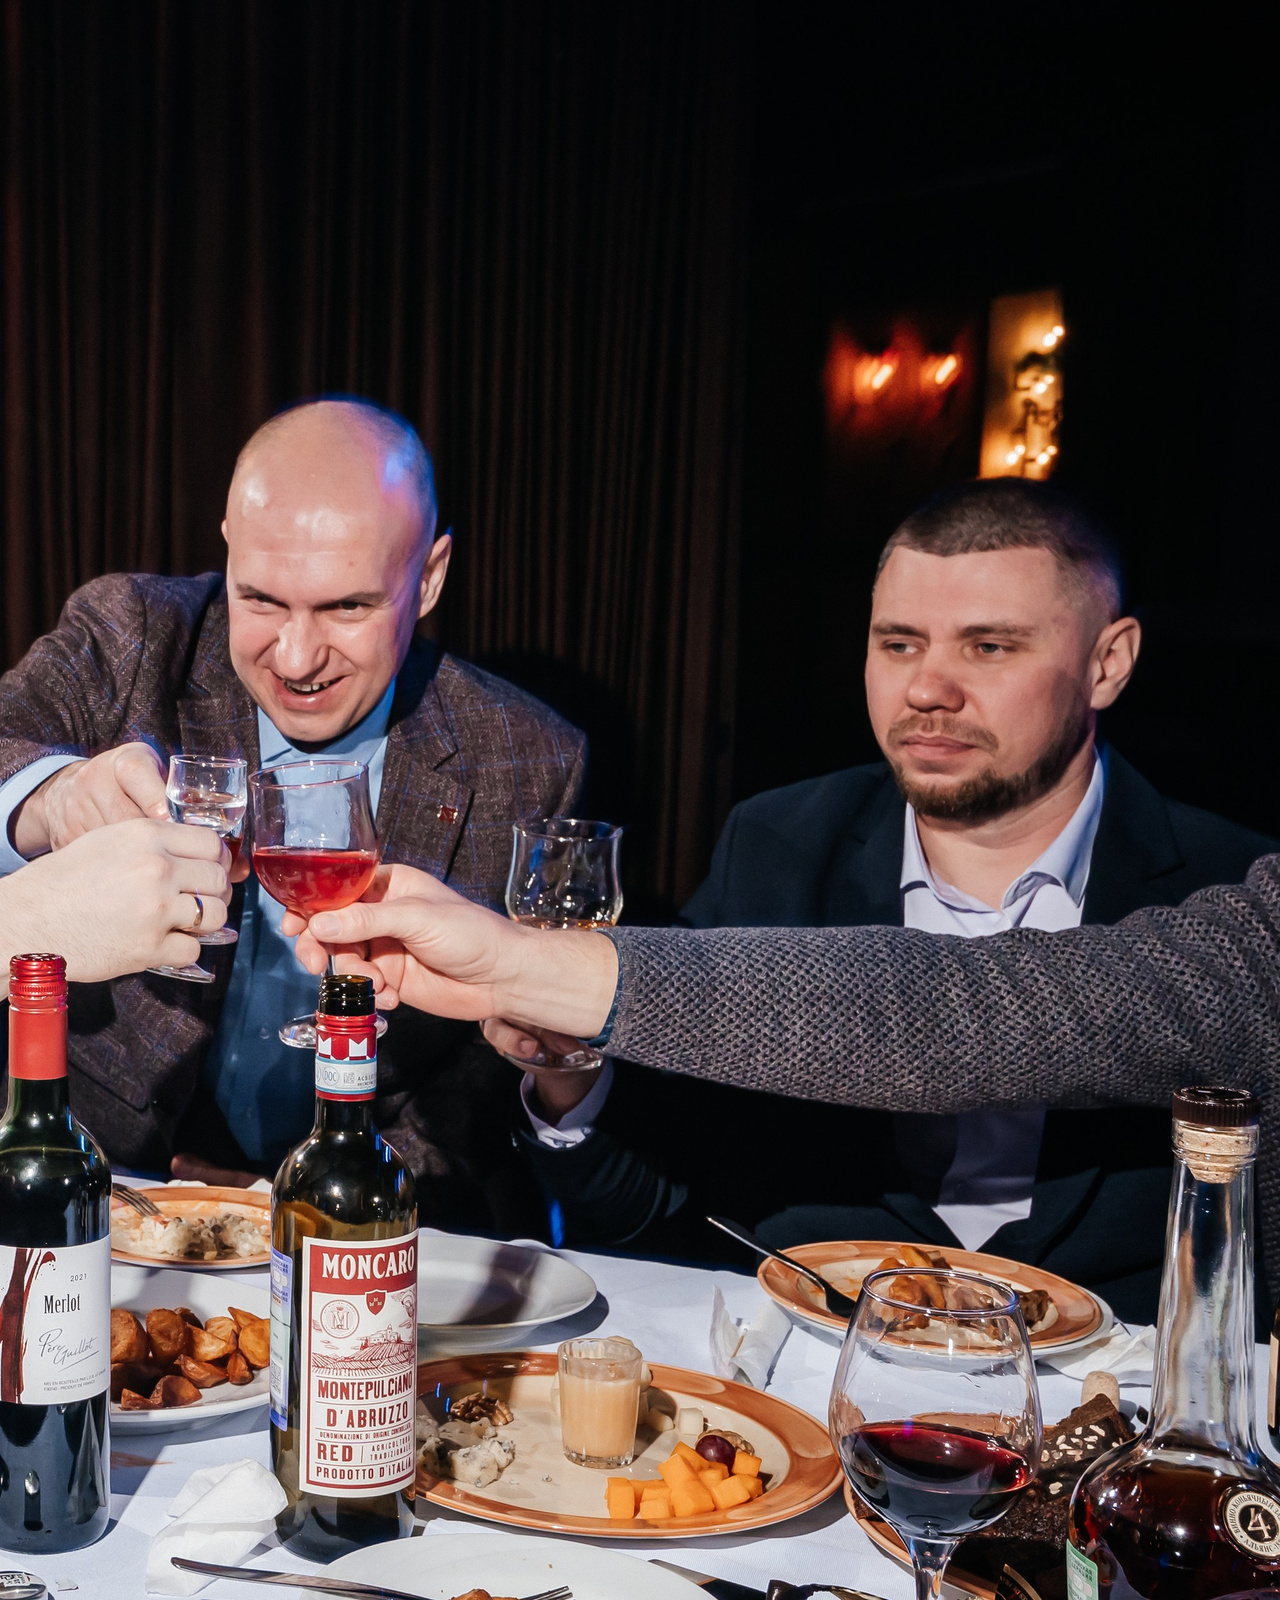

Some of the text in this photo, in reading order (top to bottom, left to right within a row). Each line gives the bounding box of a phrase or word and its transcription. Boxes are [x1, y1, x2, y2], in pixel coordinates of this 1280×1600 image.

[324, 1070, 337, 1082] DOC
[322, 1246, 415, 1280] MONCARO
[70, 1273, 87, 1282] 2021
[44, 1294, 80, 1314] Merlot
[327, 1401, 408, 1428] D'ABRUZZO
[317, 1436, 411, 1462] RED AGRICOLTURA
[370, 1444, 411, 1461] TRADIZIONALE
[316, 1466, 374, 1480] PRODOTTO
